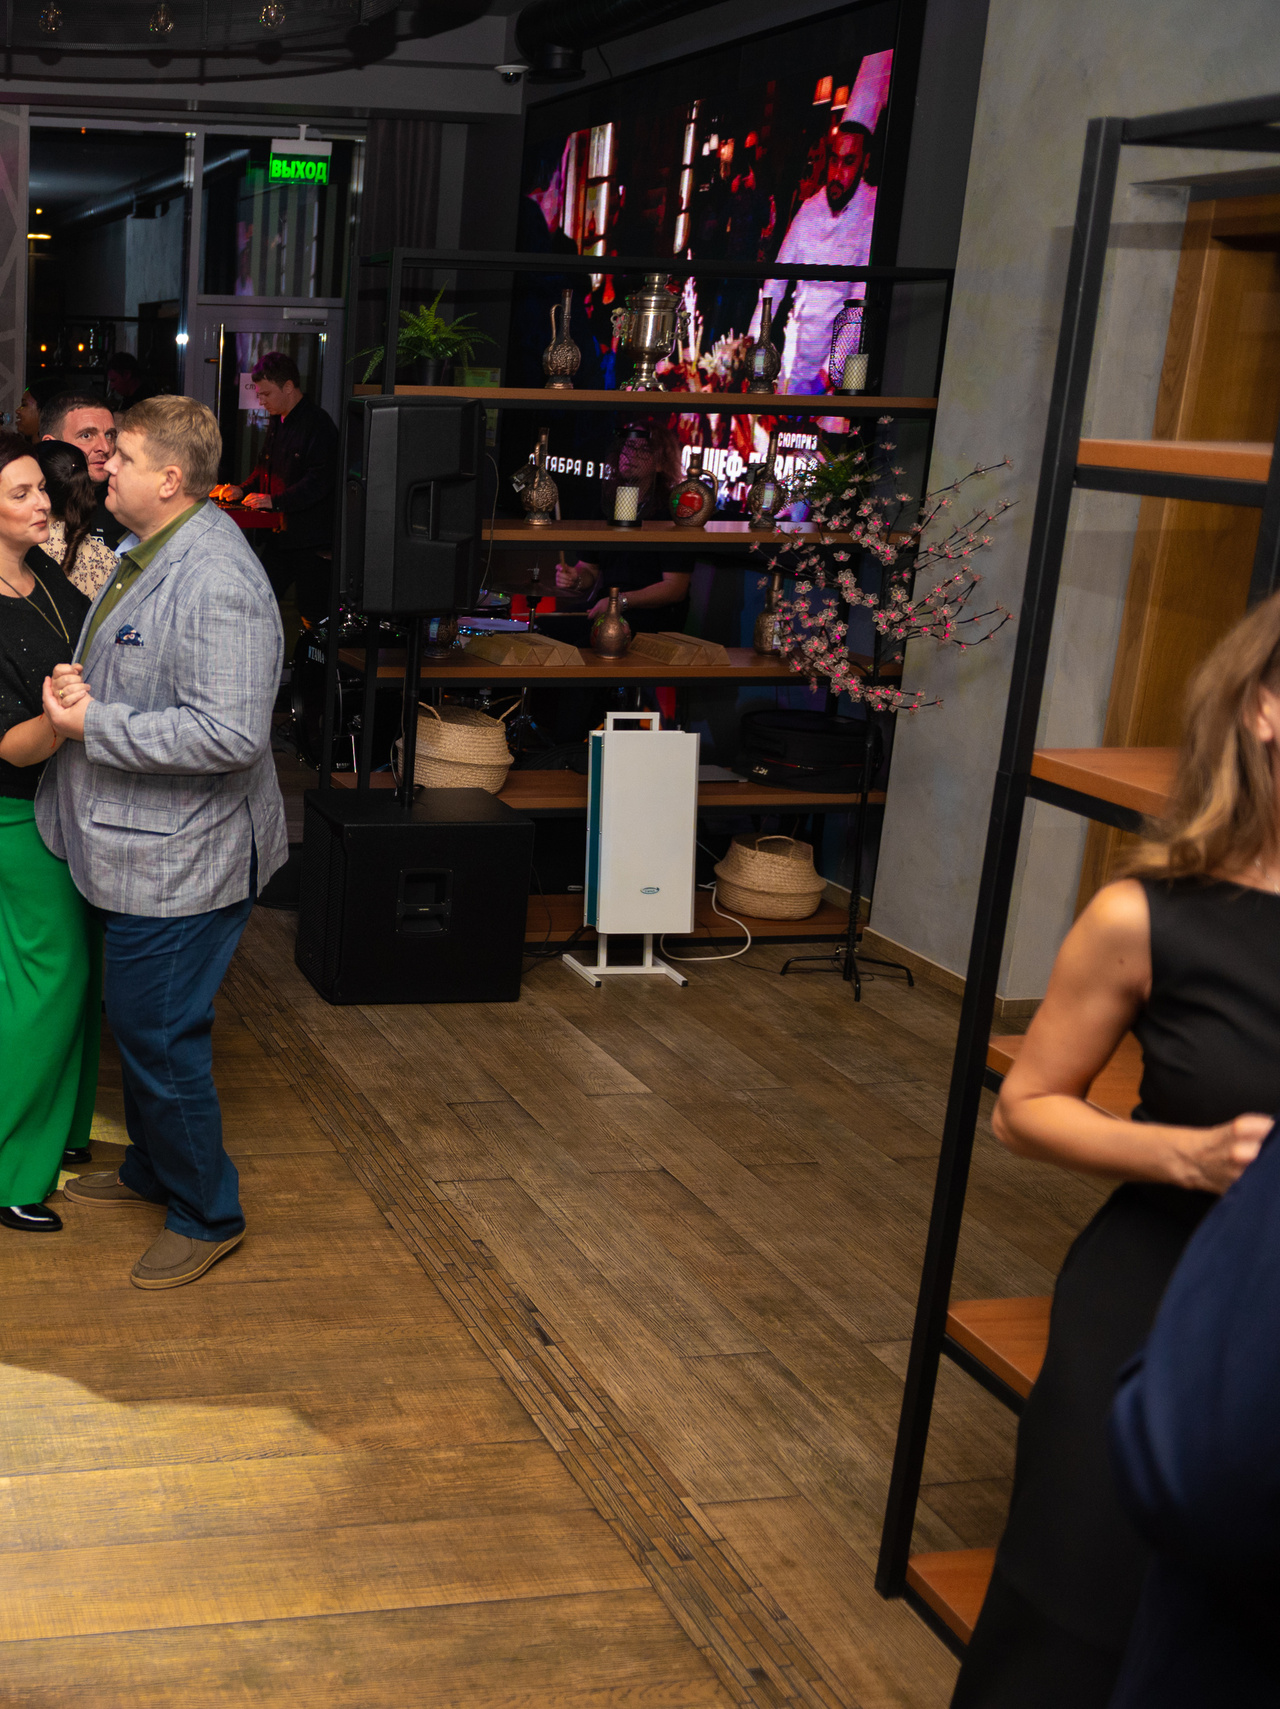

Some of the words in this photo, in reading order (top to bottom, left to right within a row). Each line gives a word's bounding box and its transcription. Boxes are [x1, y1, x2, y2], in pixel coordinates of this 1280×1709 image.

[271, 159, 327, 183] ВЫХОД
[777, 431, 818, 450] СЮРПРИЗ
[586, 461, 594, 478] В
